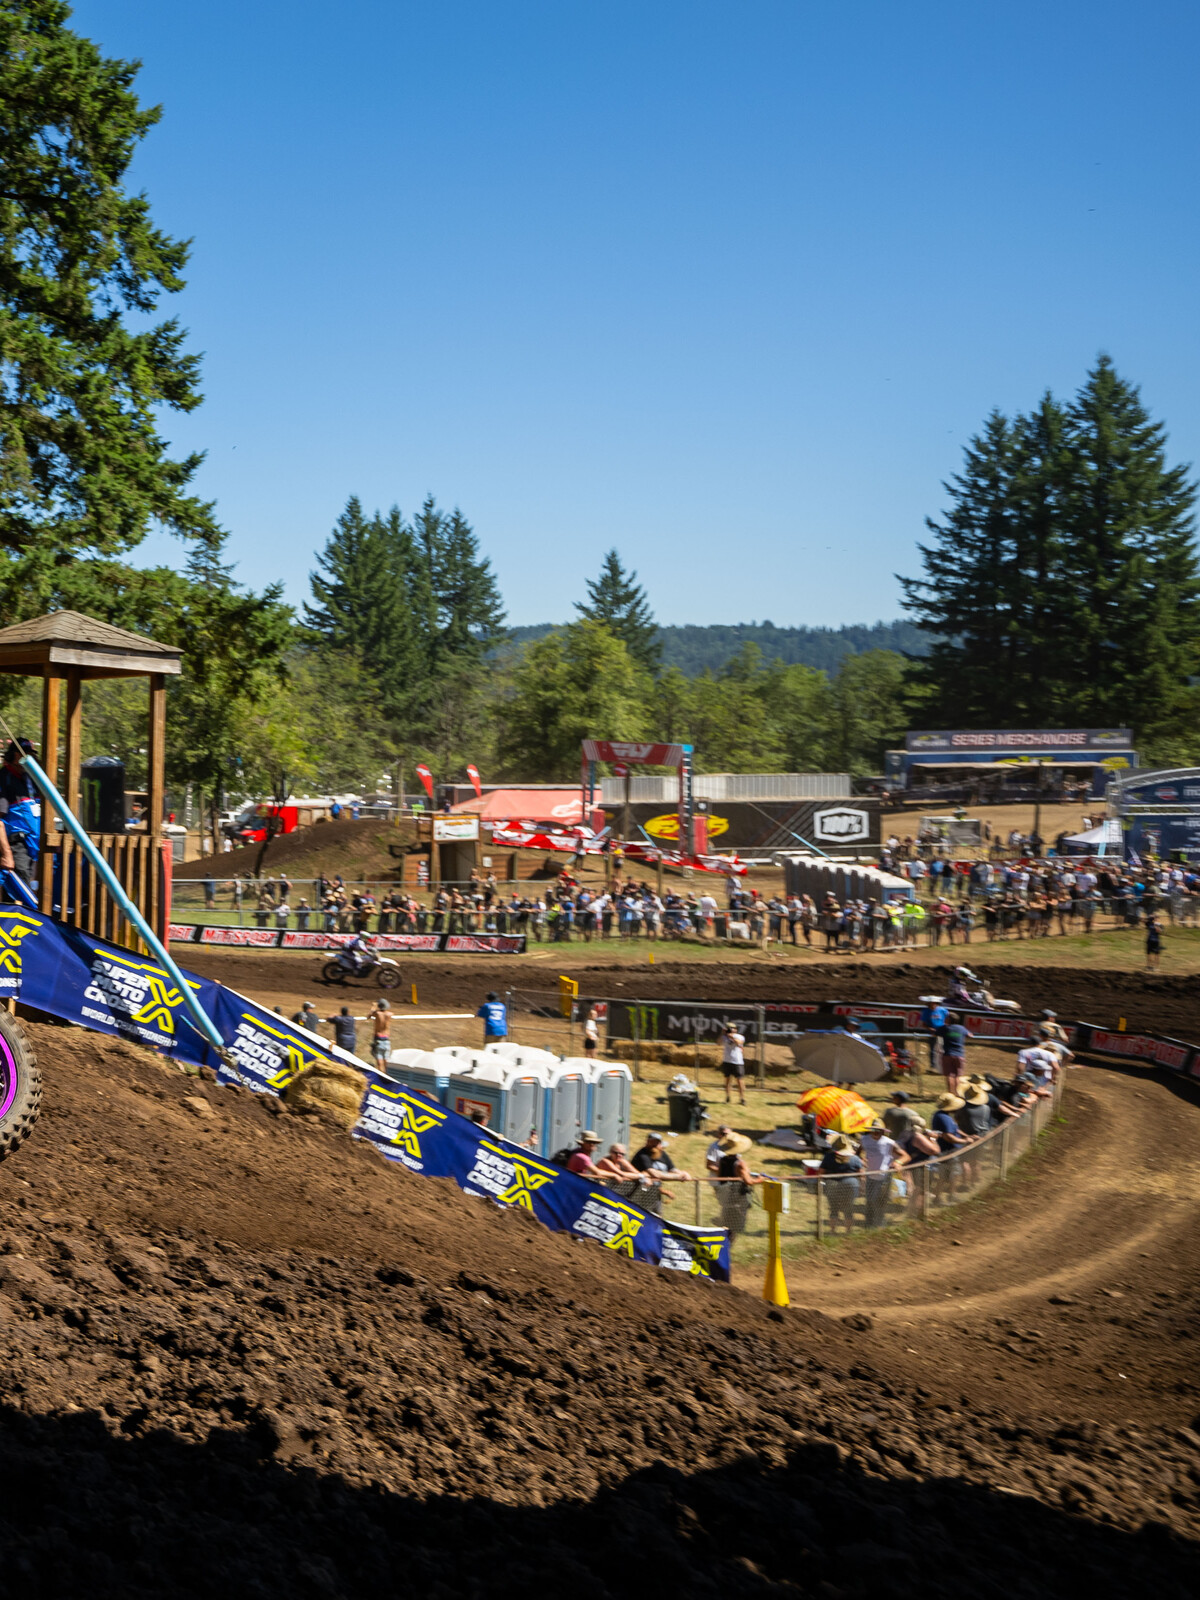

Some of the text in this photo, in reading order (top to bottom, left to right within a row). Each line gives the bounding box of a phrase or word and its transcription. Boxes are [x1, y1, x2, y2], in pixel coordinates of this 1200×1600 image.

[952, 734, 996, 746] SERIES
[996, 733, 1087, 745] MERCHANDISE
[91, 959, 151, 992] SUPER
[91, 973, 146, 1003] MOTO
[83, 985, 143, 1016] CROSS
[81, 1005, 116, 1026] WORLD
[233, 1036, 282, 1069] MOTO
[234, 1023, 291, 1059] SUPER
[363, 1105, 402, 1129] MOTO
[365, 1093, 408, 1118] SUPER
[355, 1116, 400, 1141] CROSS
[473, 1160, 512, 1186] MOTO
[474, 1148, 517, 1177] SUPER
[466, 1170, 510, 1196] CROSS
[579, 1210, 619, 1234] MOTO
[582, 1199, 623, 1225] SUPER
[572, 1219, 616, 1243] CROSS
